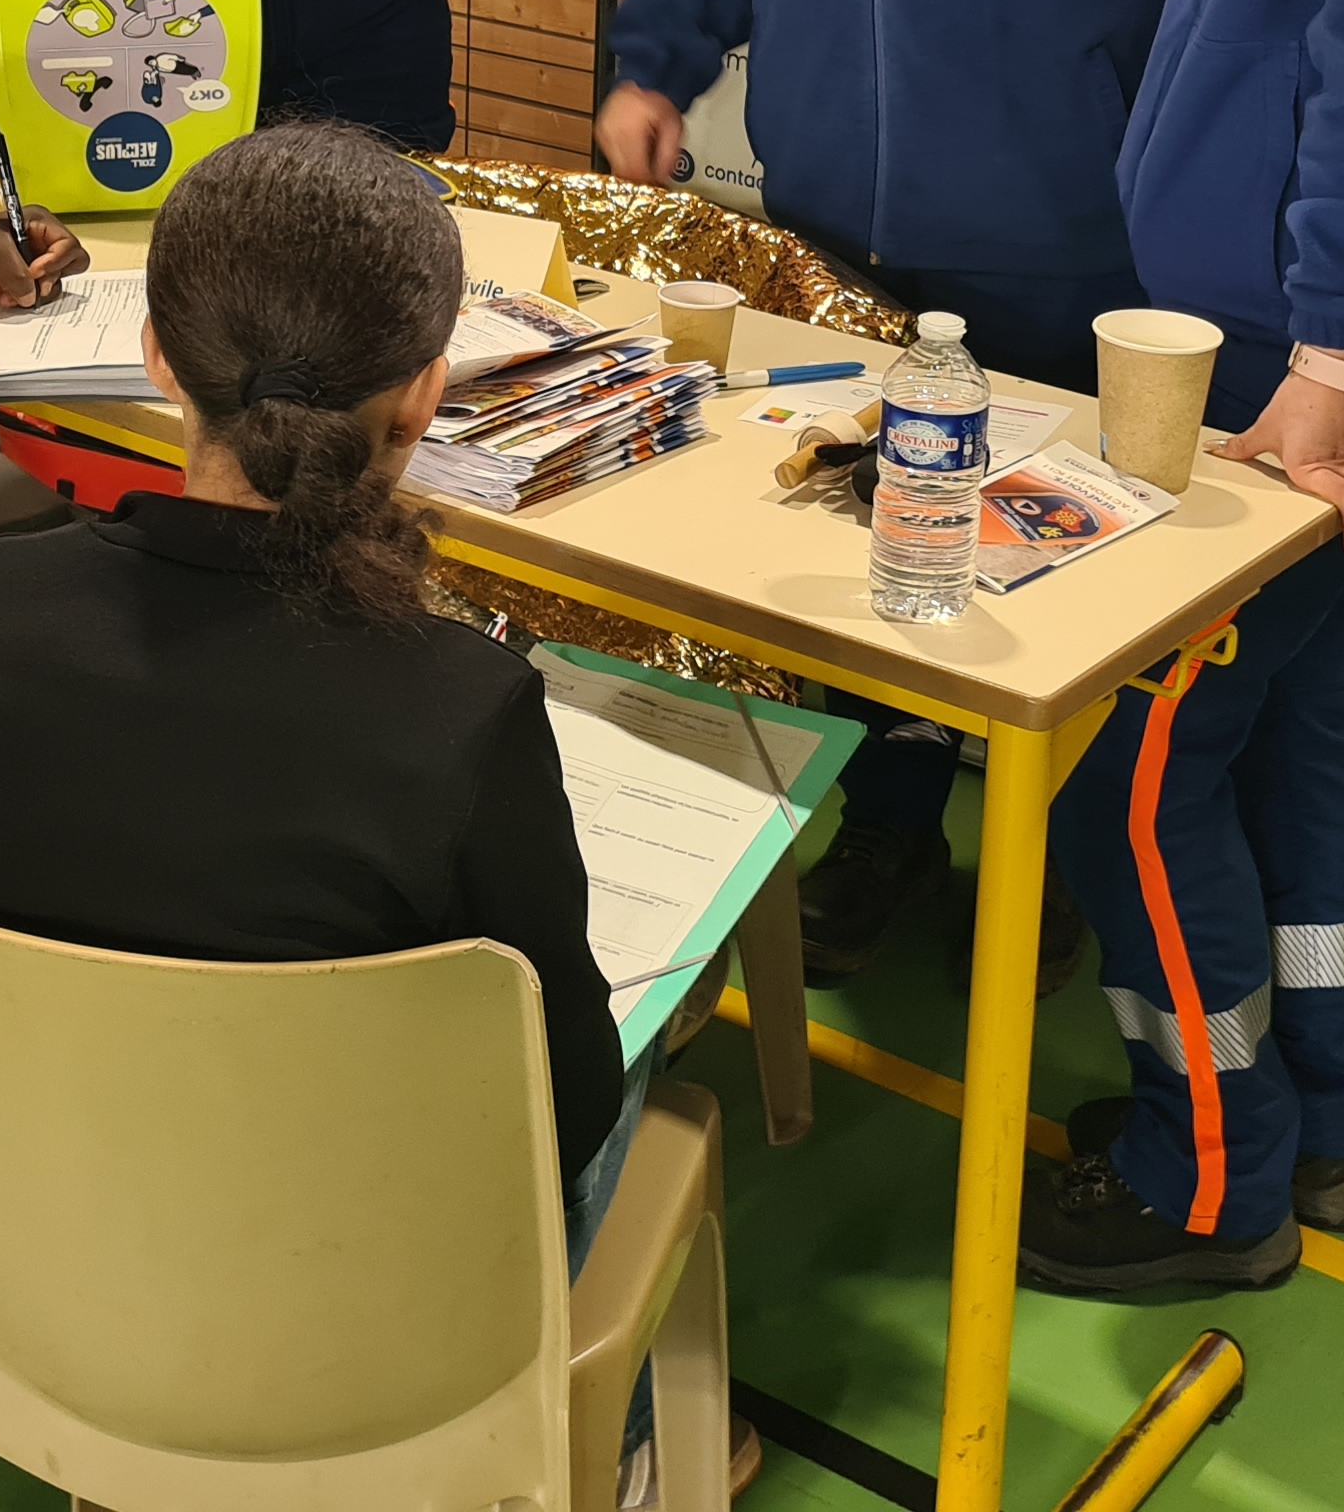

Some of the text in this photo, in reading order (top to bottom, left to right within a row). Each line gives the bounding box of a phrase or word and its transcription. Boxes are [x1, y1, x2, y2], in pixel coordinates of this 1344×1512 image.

[189, 89, 224, 101] OK?
[131, 157, 157, 168] ZOLL
[889, 430, 956, 450] CRISTALINE
